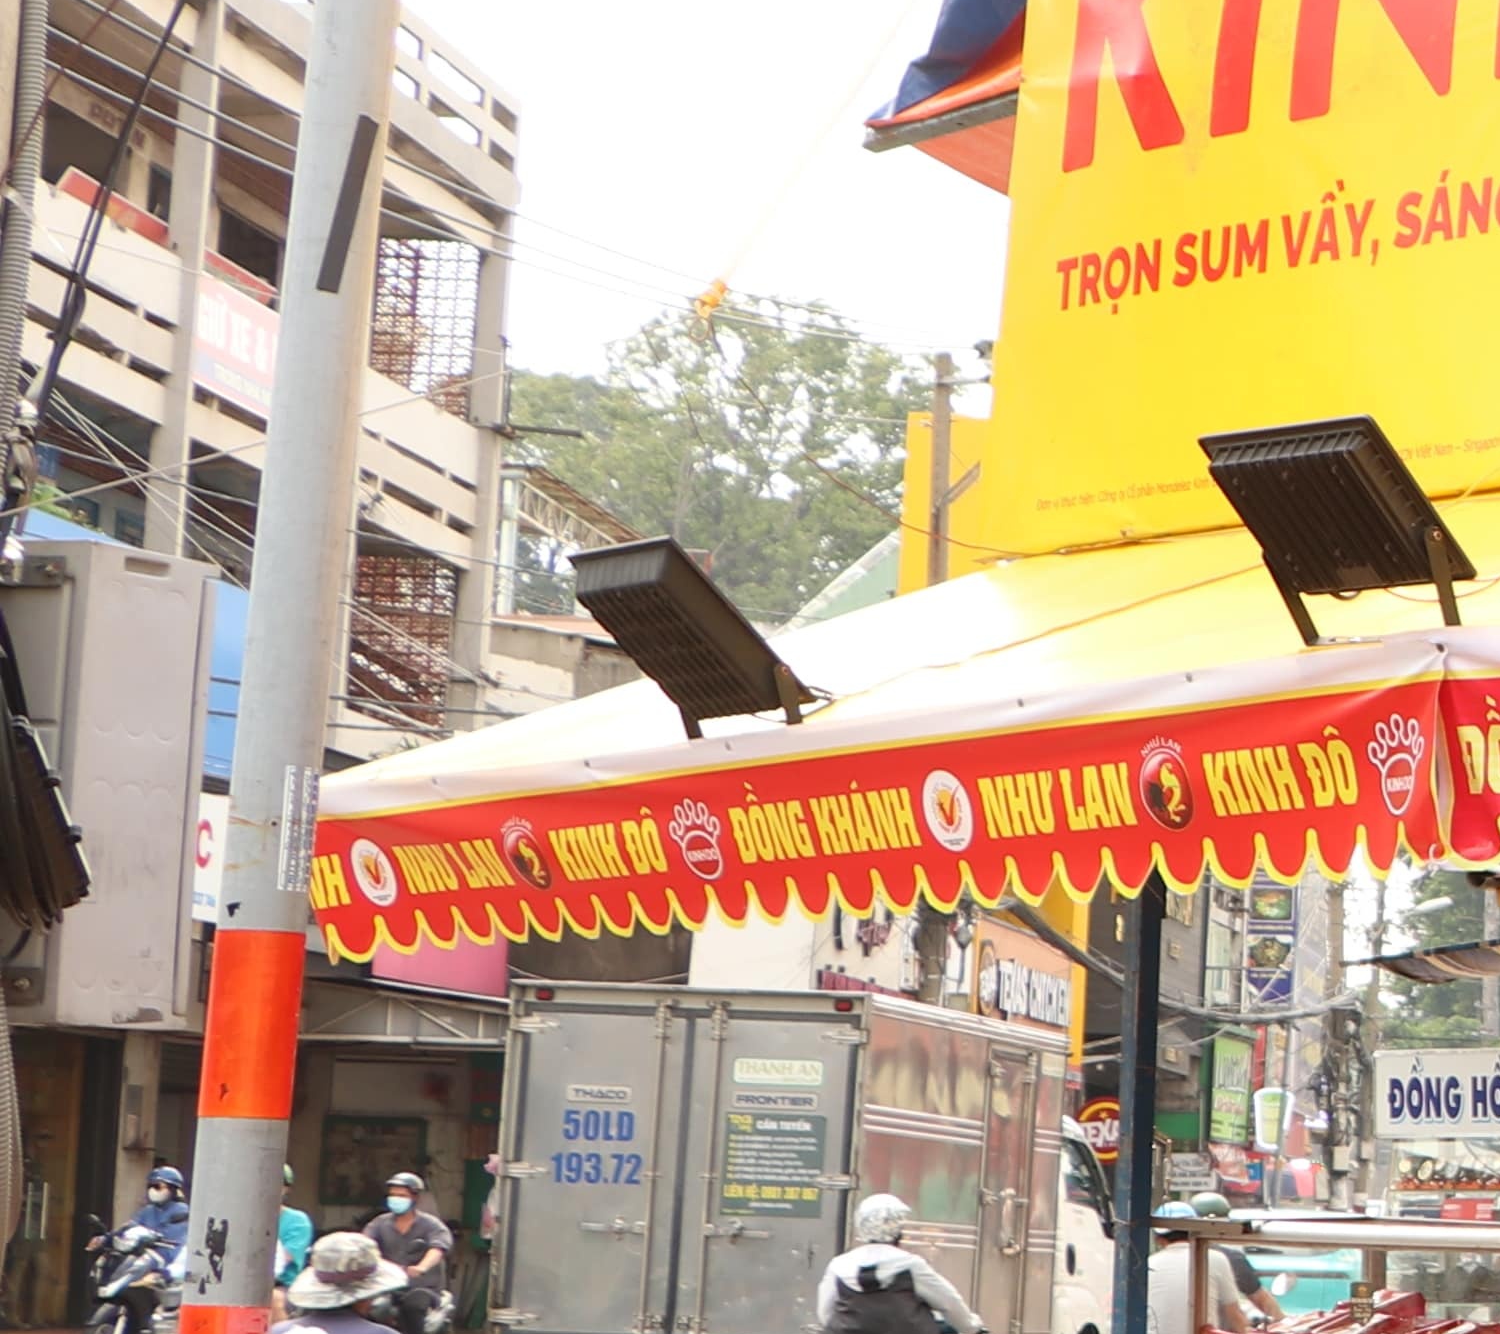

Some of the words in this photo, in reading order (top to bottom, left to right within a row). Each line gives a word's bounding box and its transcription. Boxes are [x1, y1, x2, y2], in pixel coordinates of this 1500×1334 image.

[1056, 244, 1163, 315] TRỌN
[1173, 215, 1270, 288] SUM
[976, 768, 1056, 840] NHƯ
[1058, 761, 1139, 832] LAN
[1201, 742, 1306, 818] KINH
[1297, 724, 1359, 809] ĐÔ
[547, 822, 621, 883] KINH
[621, 806, 669, 874] ĐÔ
[726, 781, 809, 865] ĐỒNG
[809, 781, 923, 854] KHÁNH
[562, 1109, 635, 1142] 50LD
[1387, 1056, 1463, 1120] ĐỒNG
[550, 1152, 643, 1185] 193.72
